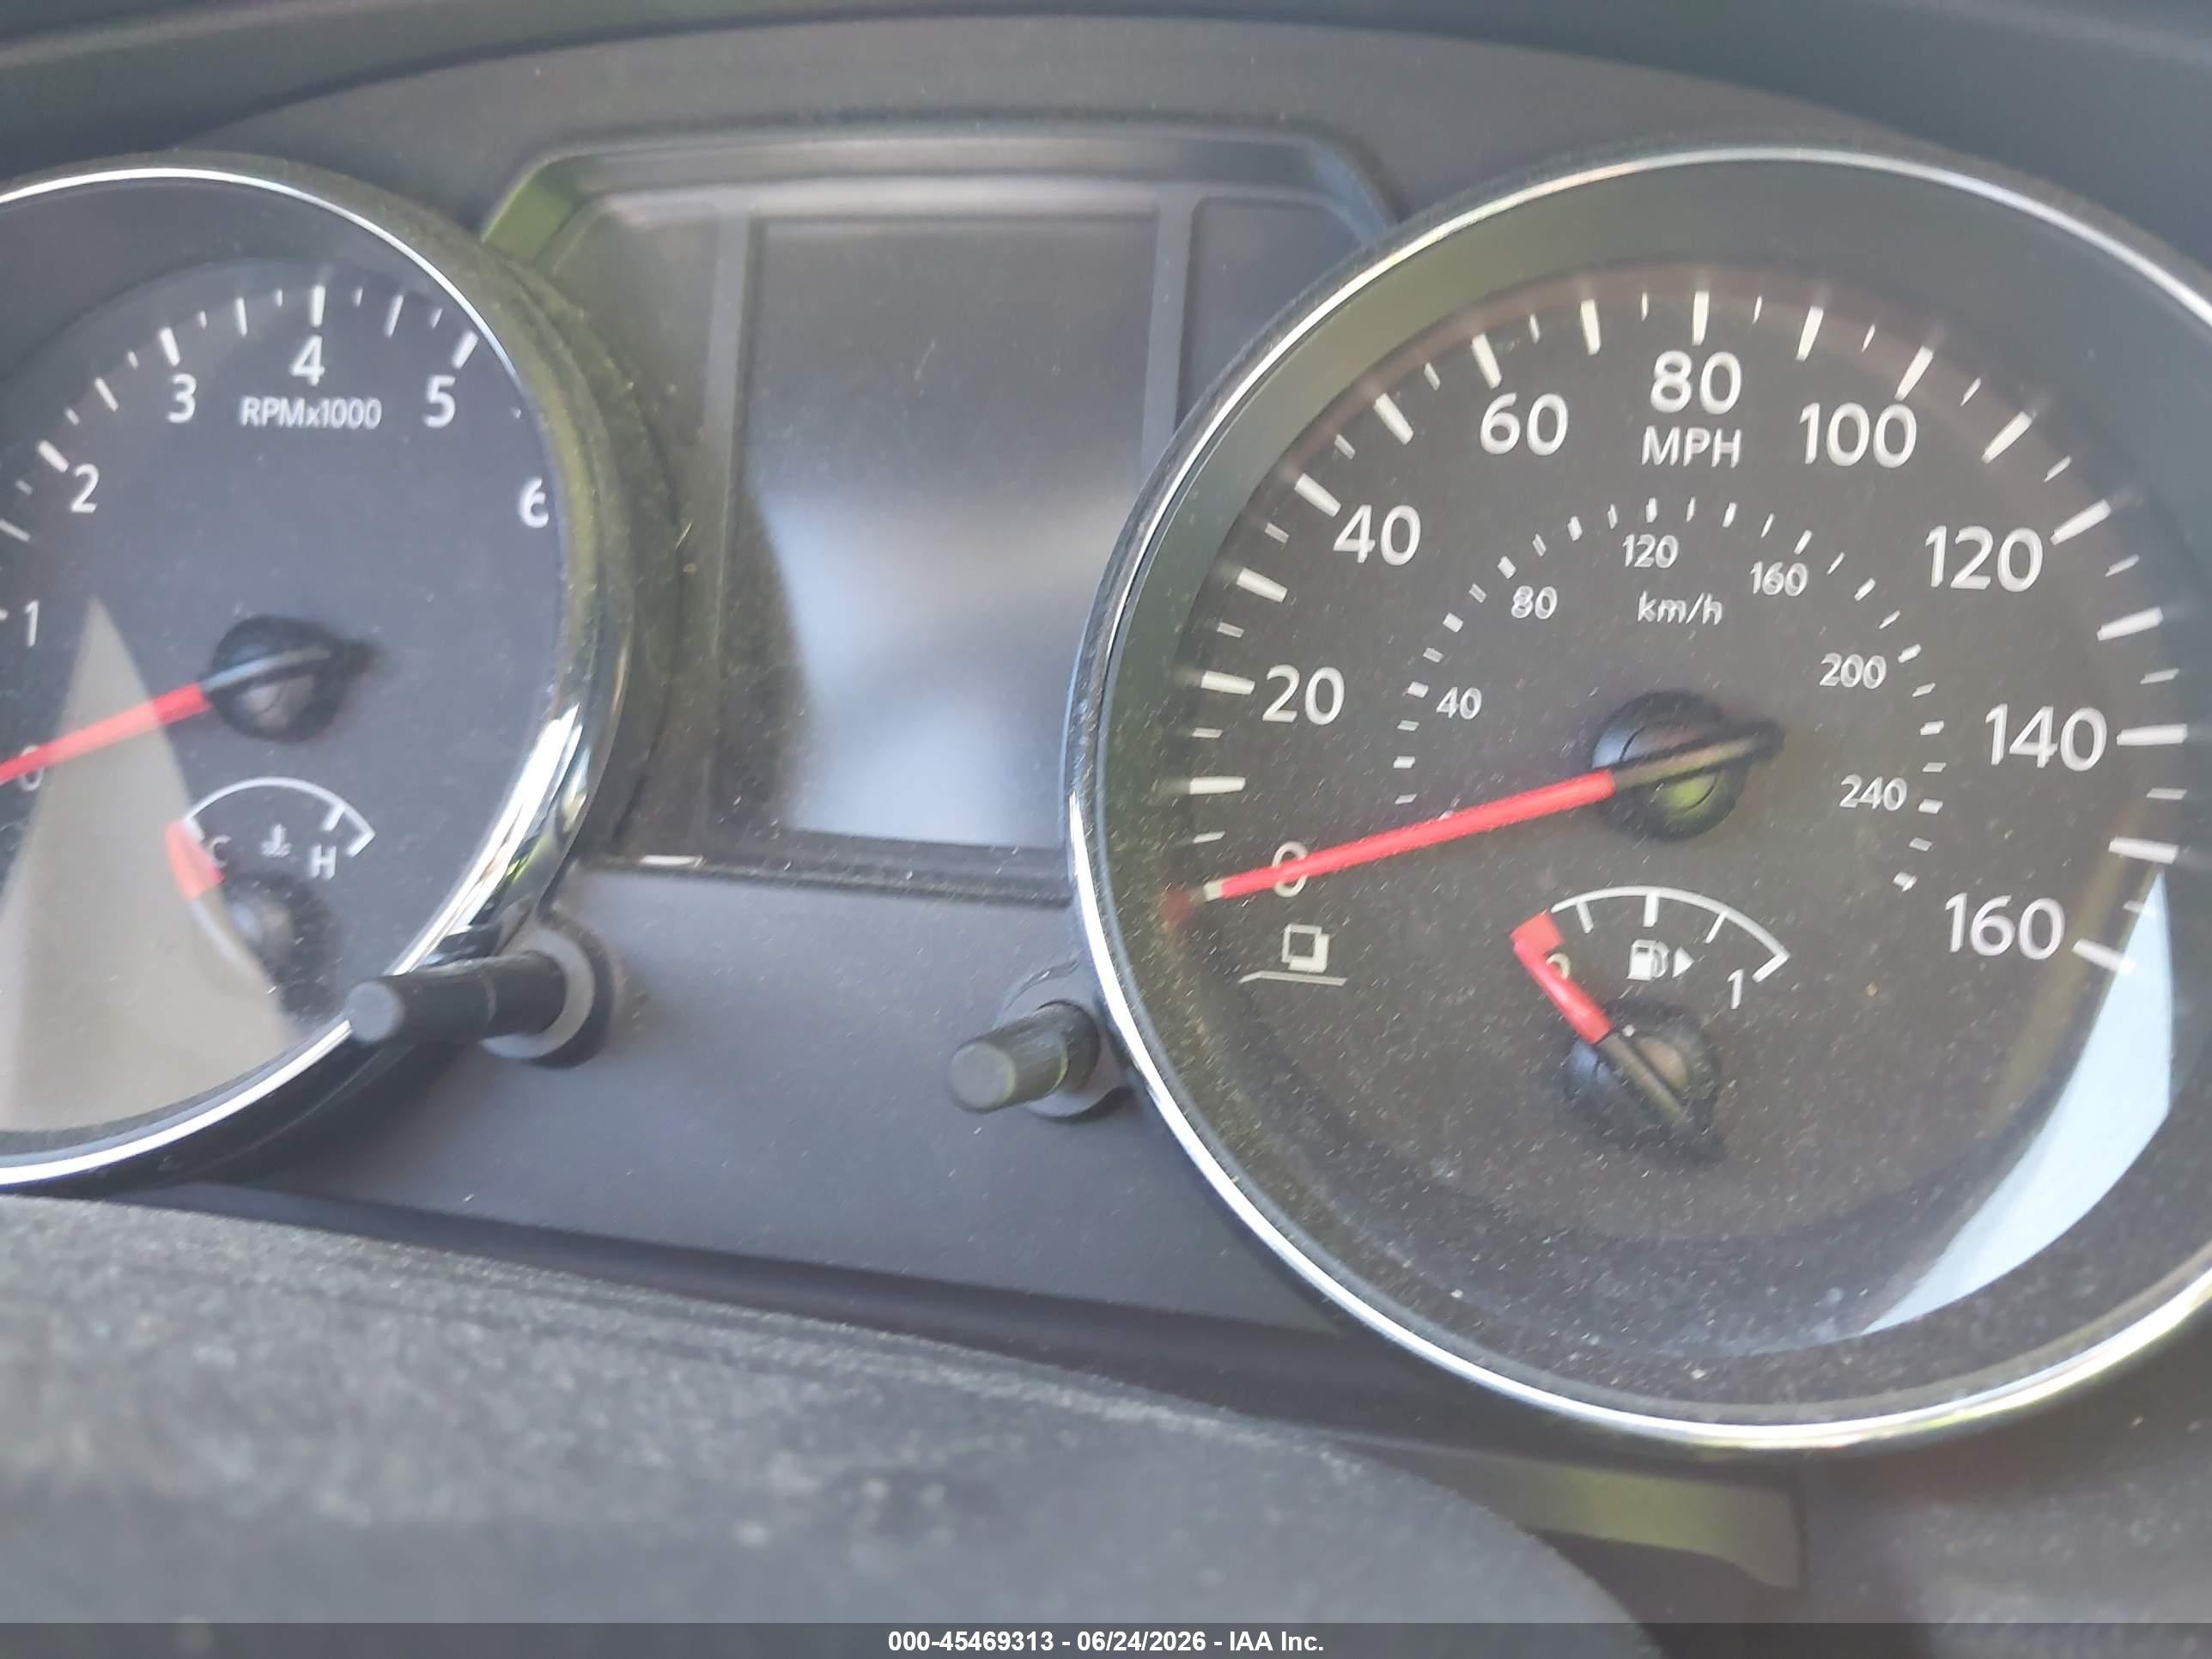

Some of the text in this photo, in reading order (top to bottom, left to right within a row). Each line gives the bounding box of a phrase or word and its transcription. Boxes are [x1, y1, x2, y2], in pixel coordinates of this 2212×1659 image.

[290, 336, 325, 386] 4
[1650, 350, 1742, 414] 80
[168, 374, 197, 422] 3
[240, 397, 381, 429] RPMx1000
[422, 375, 455, 427] 5
[1480, 392, 1568, 455] 60
[1641, 426, 1741, 468] MPH
[1800, 403, 1917, 468] 100
[70, 465, 99, 513] 2
[520, 477, 549, 528] 6
[1334, 504, 1421, 566] 40
[1622, 533, 1679, 568] 120
[1925, 526, 2044, 592] 120
[1510, 586, 1558, 620] 80
[1750, 561, 1808, 597] 160
[24, 600, 39, 647] 1
[1637, 592, 1723, 625] km/h
[1262, 665, 1346, 725] 20
[1819, 653, 1887, 689] 200
[1437, 687, 1482, 720] 40
[1984, 703, 2106, 771] 140
[1839, 775, 1907, 811] 240
[310, 844, 337, 879] H
[1272, 841, 1309, 898] 0
[1944, 891, 2065, 960] 160
[1726, 969, 1745, 1010] 1
